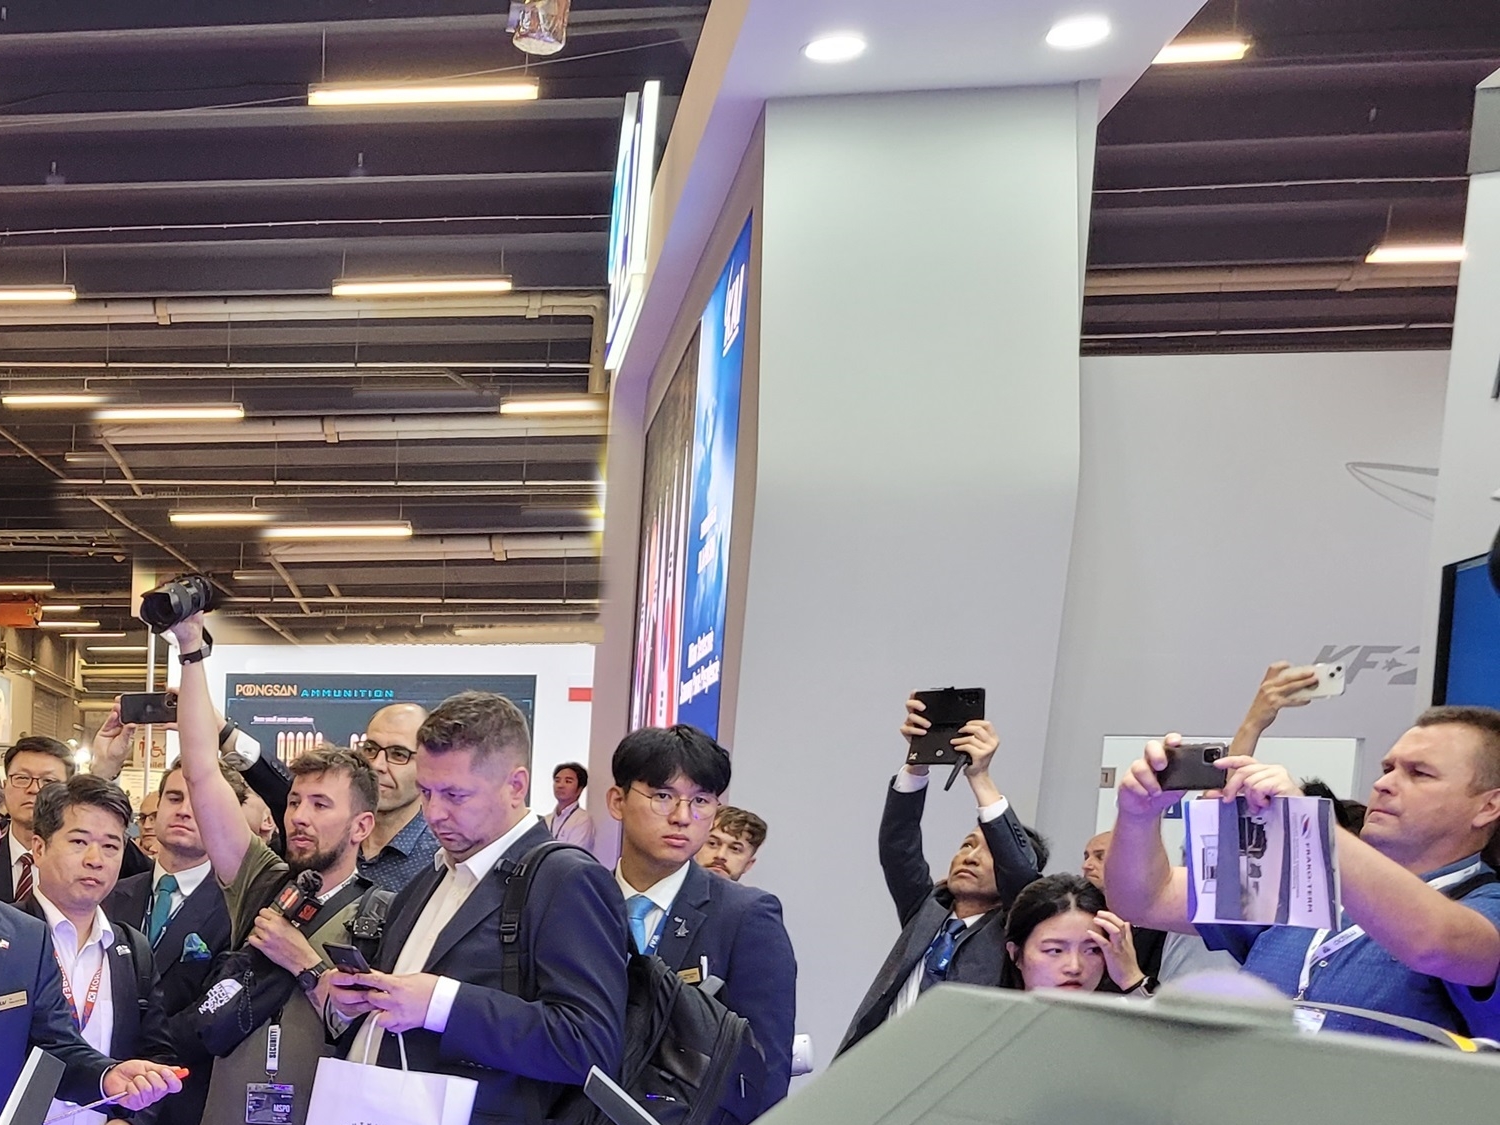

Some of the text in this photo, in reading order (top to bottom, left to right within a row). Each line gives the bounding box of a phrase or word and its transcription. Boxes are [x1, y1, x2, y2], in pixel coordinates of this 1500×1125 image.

[235, 684, 395, 699] POONGSAN AMMUNITION
[198, 990, 228, 1014] NORTH
[209, 995, 231, 1014] FACE
